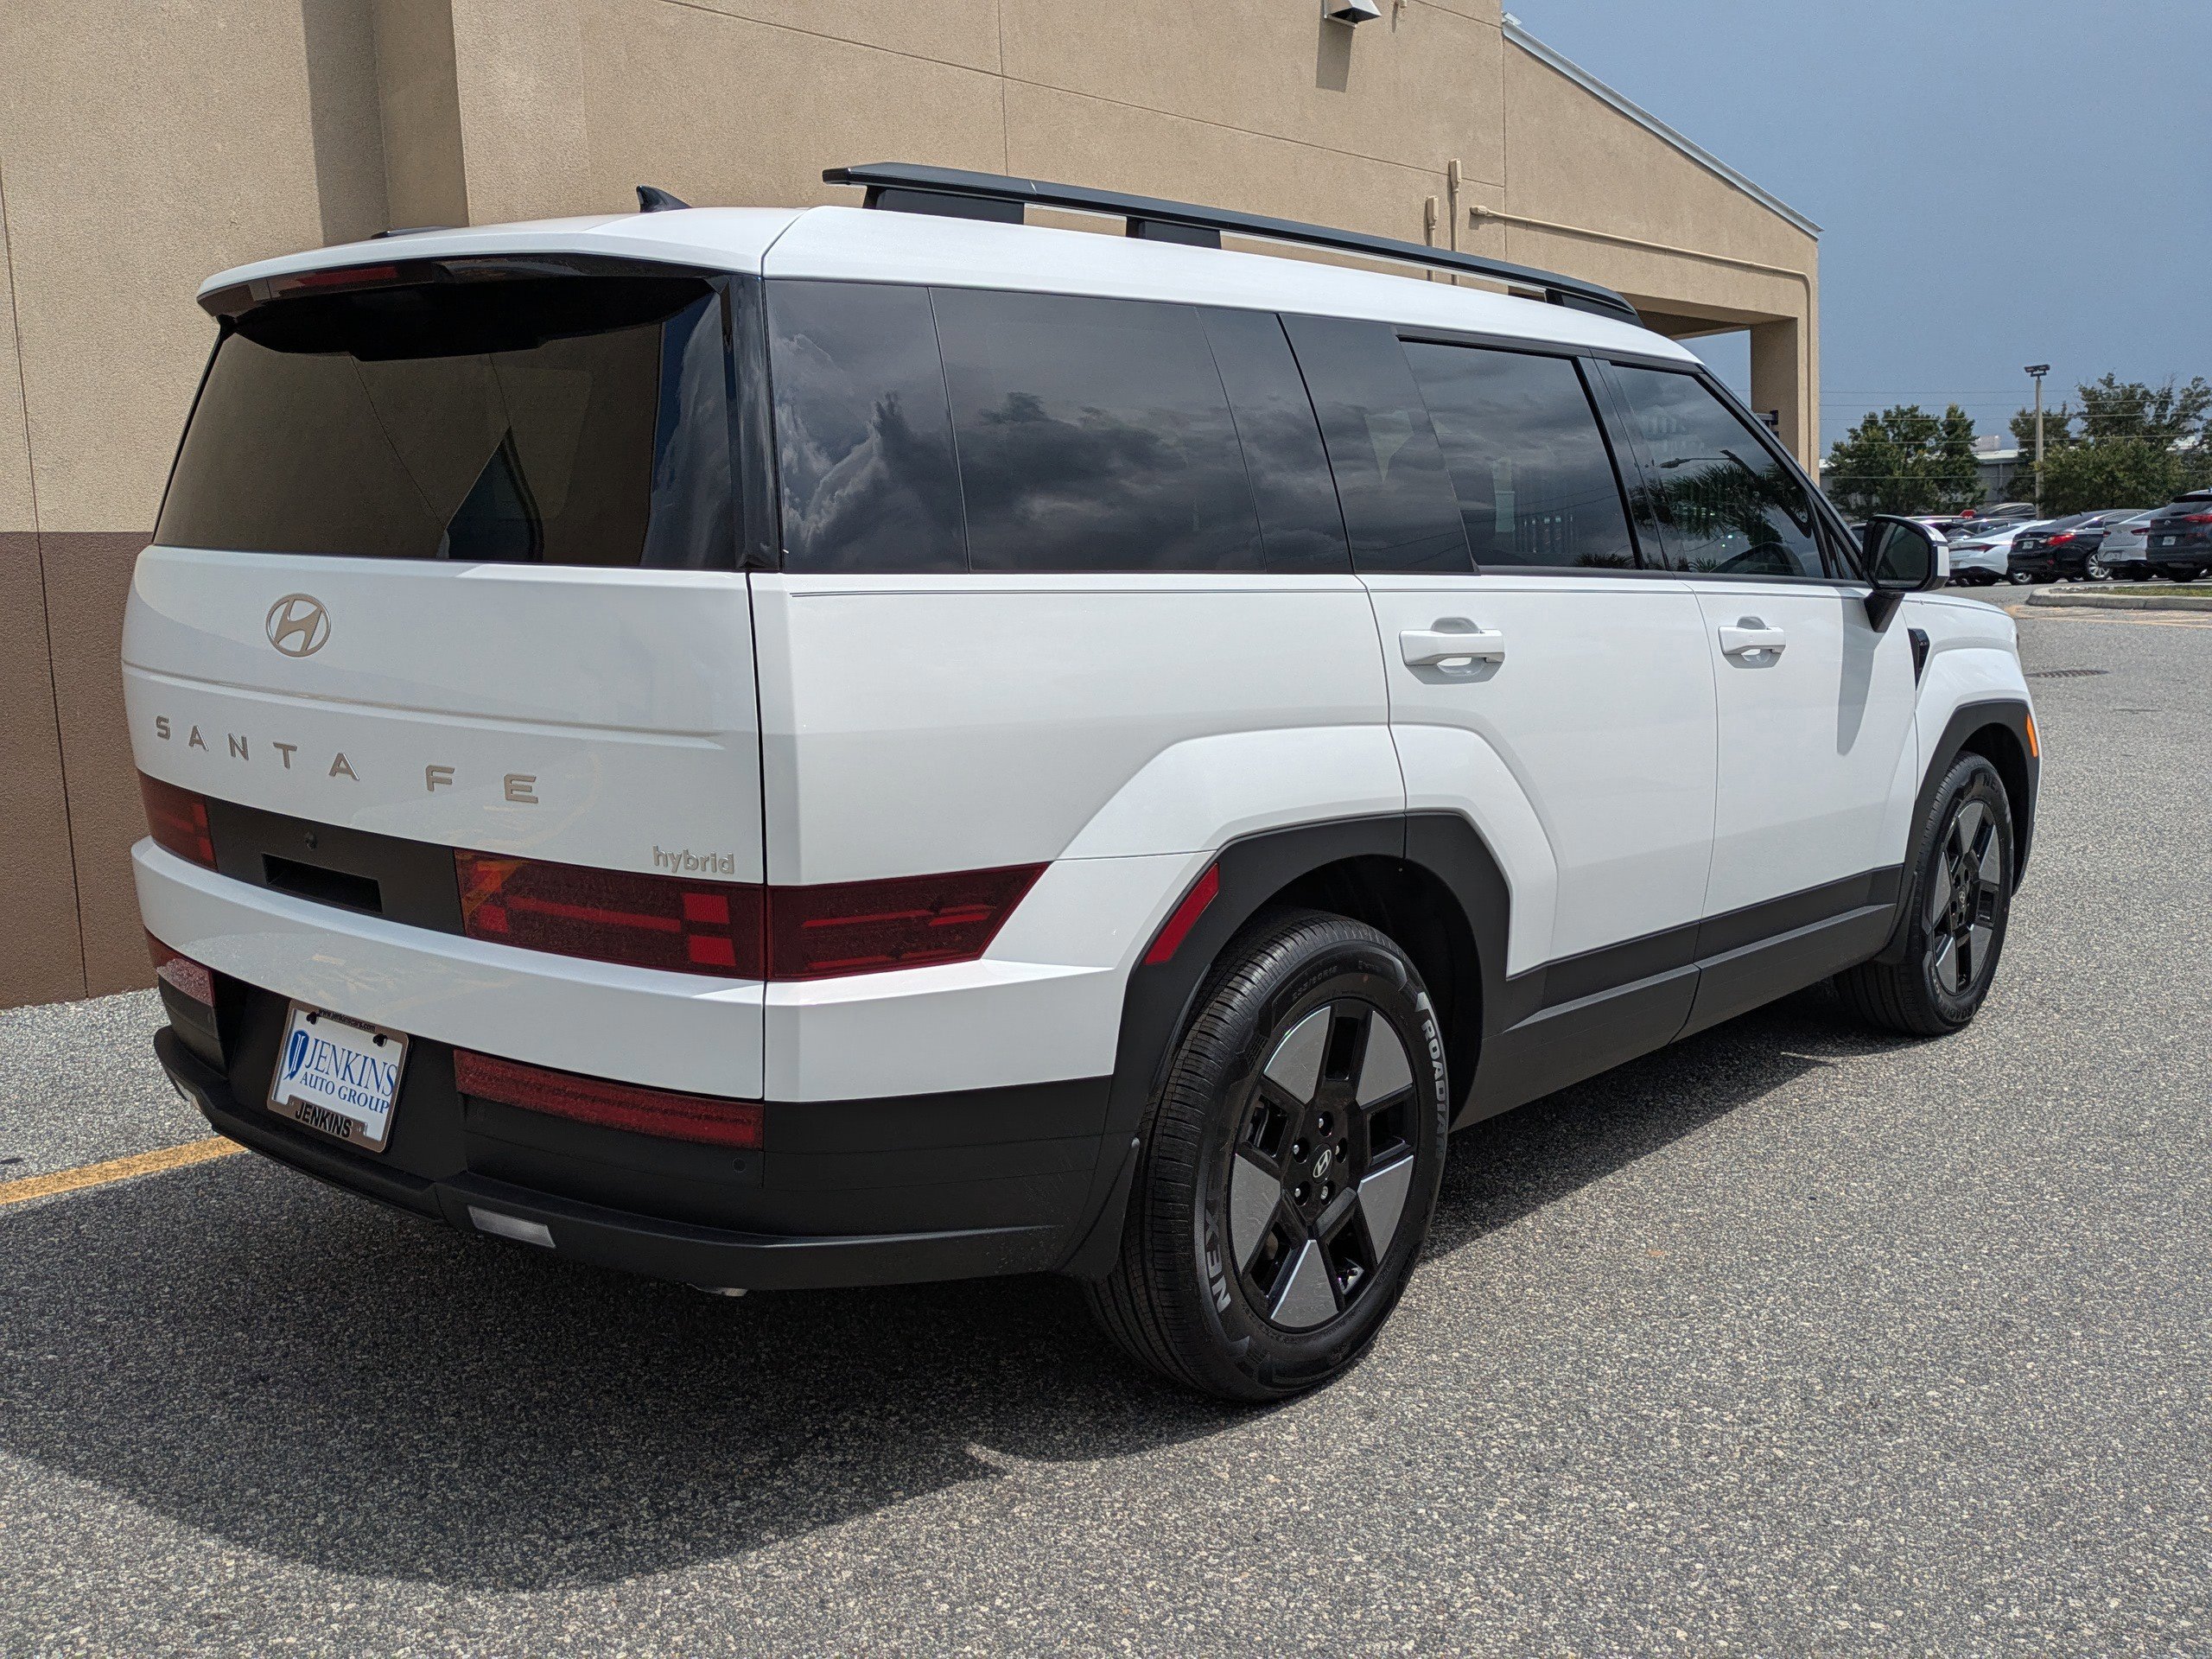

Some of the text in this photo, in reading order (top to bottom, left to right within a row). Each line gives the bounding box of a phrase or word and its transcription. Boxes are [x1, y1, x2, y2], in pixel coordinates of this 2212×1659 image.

[156, 715, 539, 804] SANTA FE
[652, 845, 734, 874] hybrid
[305, 1037, 397, 1096] JENKINS
[300, 1071, 390, 1115] AUTO GROUP
[295, 1101, 353, 1138] JENKINS
[1205, 1166, 1231, 1313] NEX
